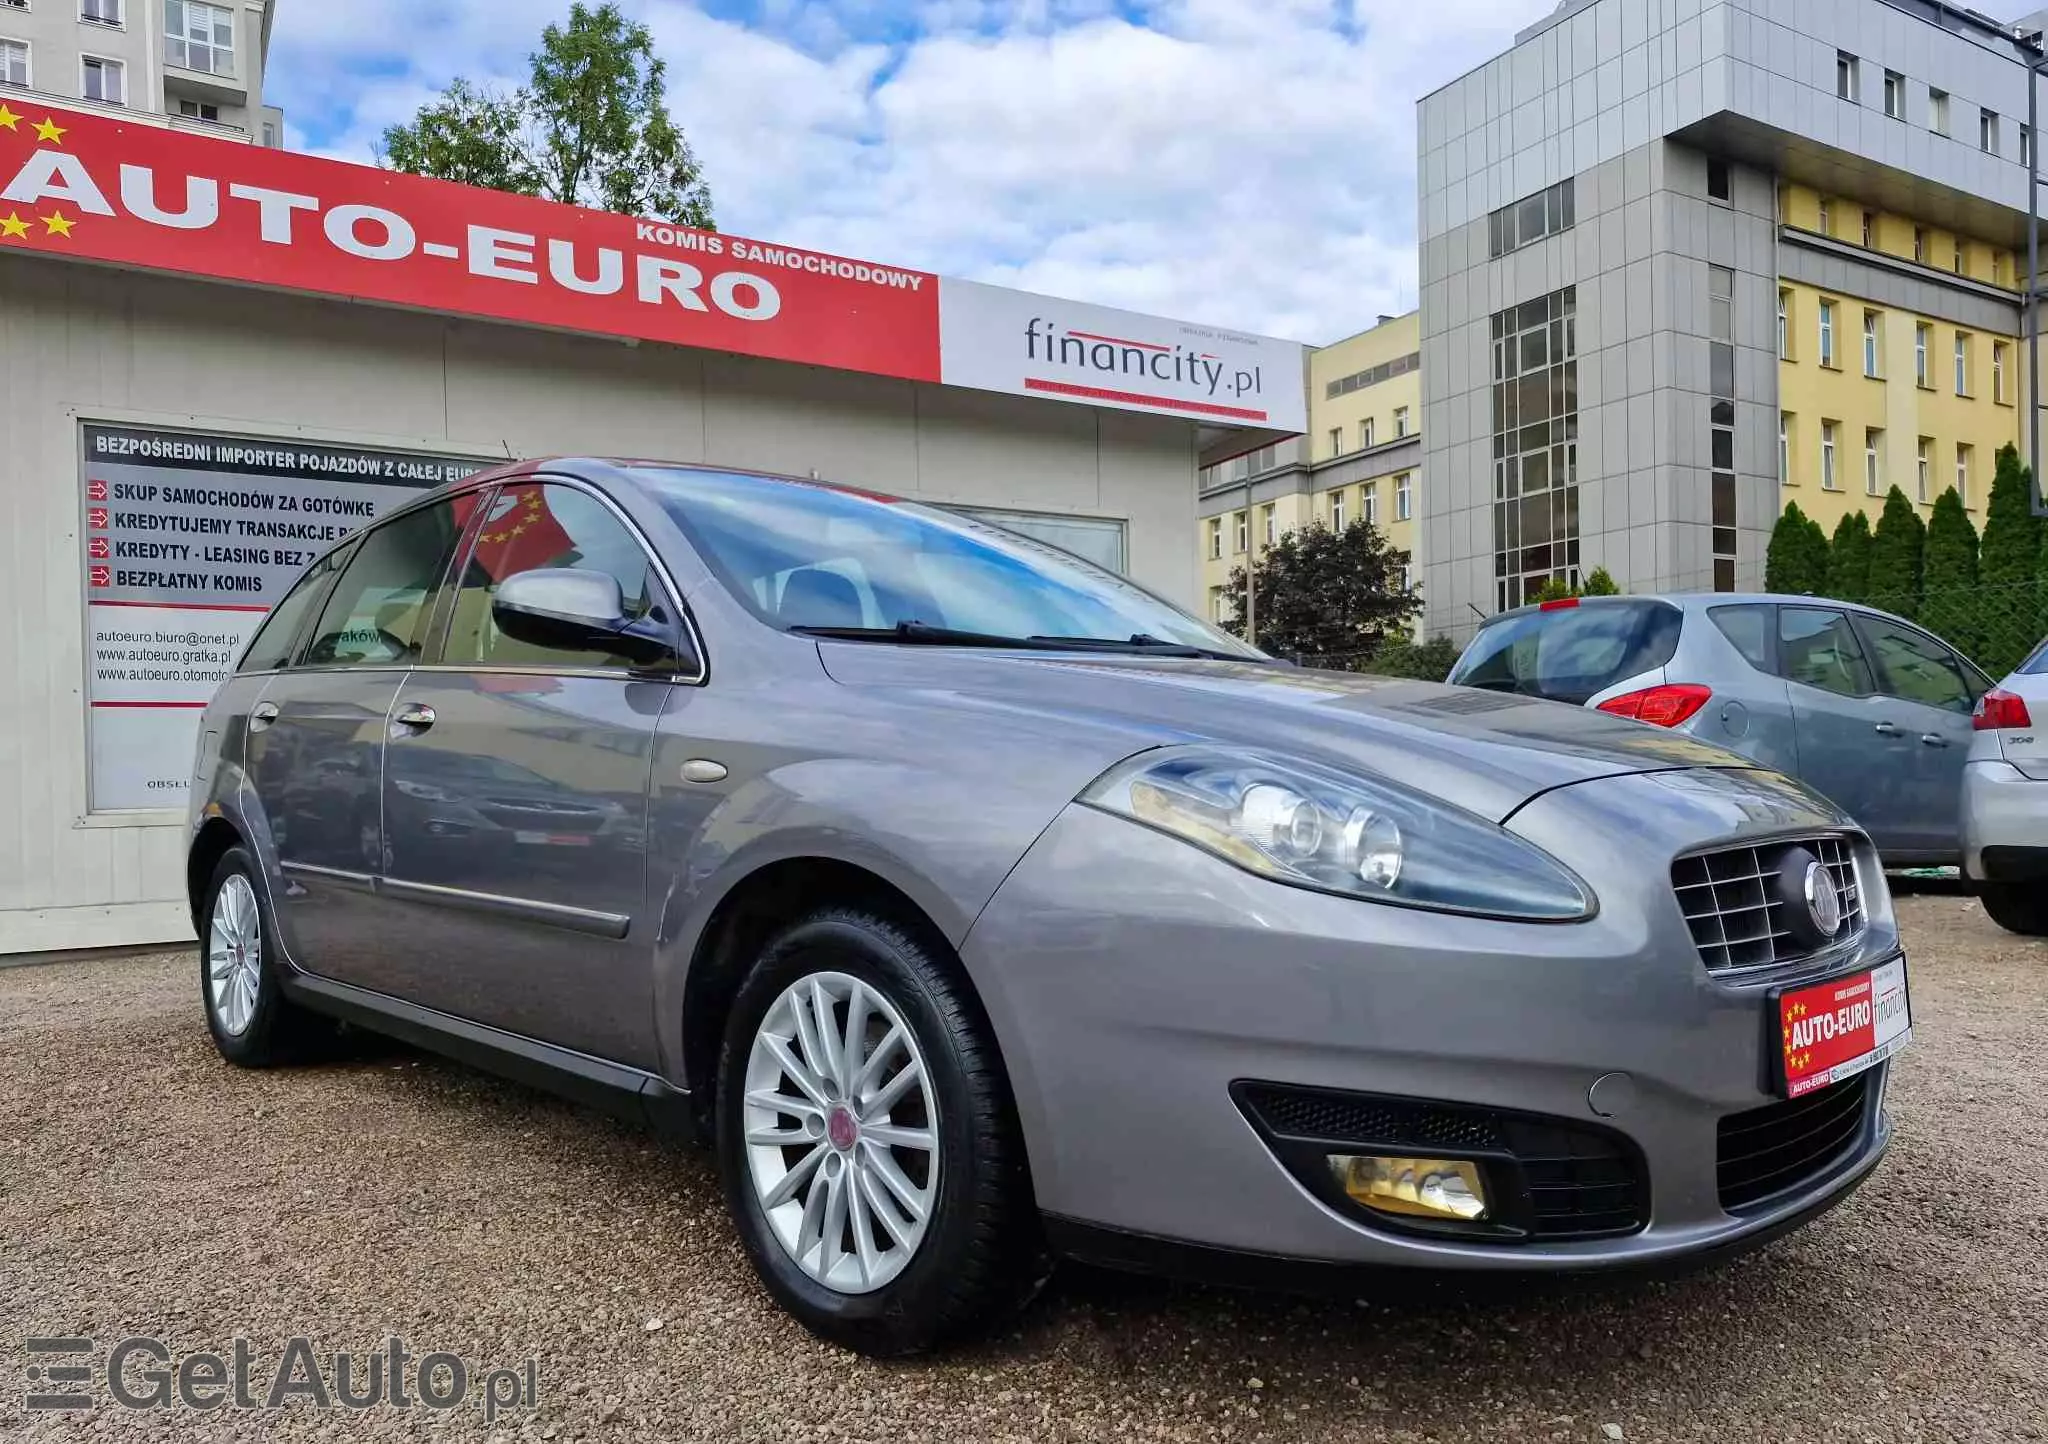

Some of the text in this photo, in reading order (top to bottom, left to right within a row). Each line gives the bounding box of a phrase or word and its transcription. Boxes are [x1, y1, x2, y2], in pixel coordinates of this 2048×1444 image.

[2, 149, 783, 321] AUTO-EURO
[635, 223, 923, 292] KOMIS SAMOCHODOWY
[1023, 316, 1261, 398] financity.pl
[96, 436, 211, 461] BEZPOŚREDNI
[216, 446, 296, 469] IMPORTER
[300, 454, 380, 475] POJAZDÓW
[384, 461, 394, 477] Z
[398, 463, 442, 481] CAŁEJ
[114, 483, 375, 519] SKUP SAMOCHODÓW ZA GOTÓWKĘ
[115, 512, 232, 535] KREDYTUJEMY
[237, 520, 334, 541] TRANSAKCJE
[115, 541, 190, 561] KREDYTY
[204, 546, 270, 565] LEASING
[274, 550, 303, 566] BEZ
[116, 570, 263, 592] BEZPŁATNY KOMIS
[96, 631, 240, 647] autoeuro.biuro@onet.pl
[96, 649, 231, 665] www.autoeuro.gratka.pl
[1791, 999, 1871, 1051] AUTO-EURO
[1792, 1071, 1830, 1094] AUTO-EURO
